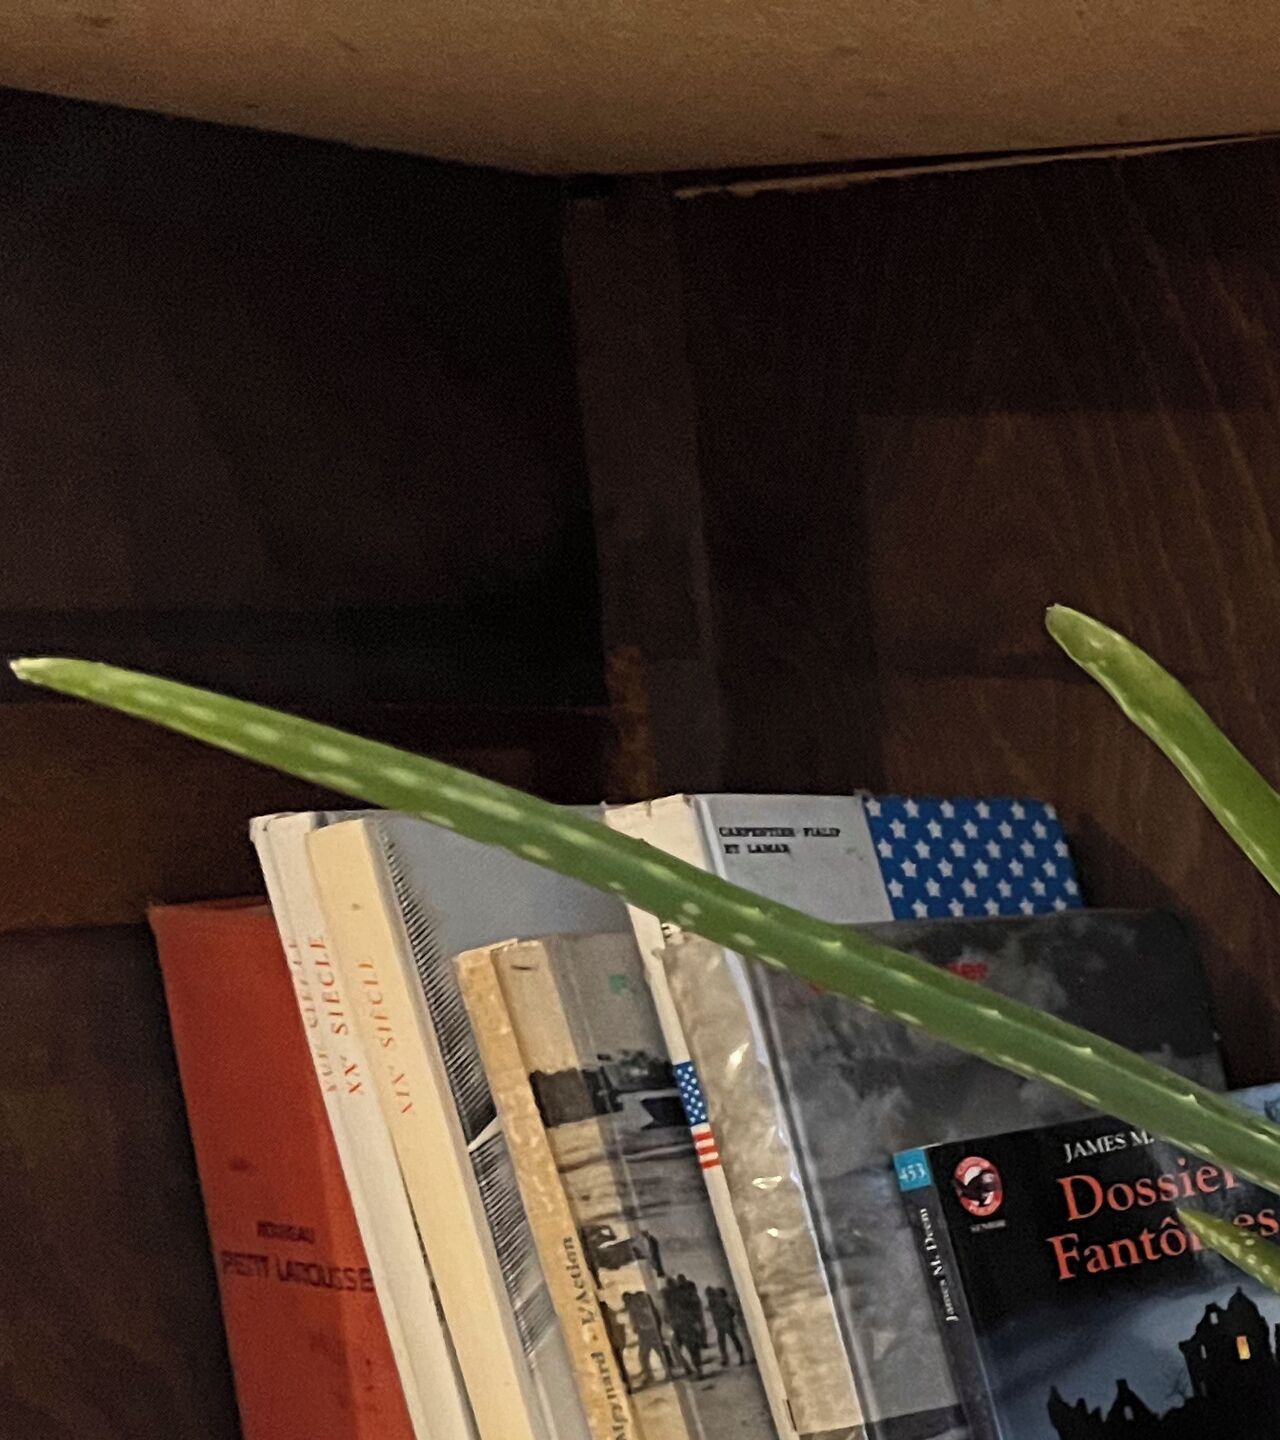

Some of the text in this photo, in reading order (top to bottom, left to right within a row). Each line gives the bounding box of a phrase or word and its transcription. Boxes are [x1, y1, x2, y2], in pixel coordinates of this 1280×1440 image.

[899, 1162, 926, 1182] 453
[1063, 1132, 1127, 1164] JAMES
[1056, 1157, 1241, 1222] Dossier
[1046, 1208, 1280, 1281] Fantôes
